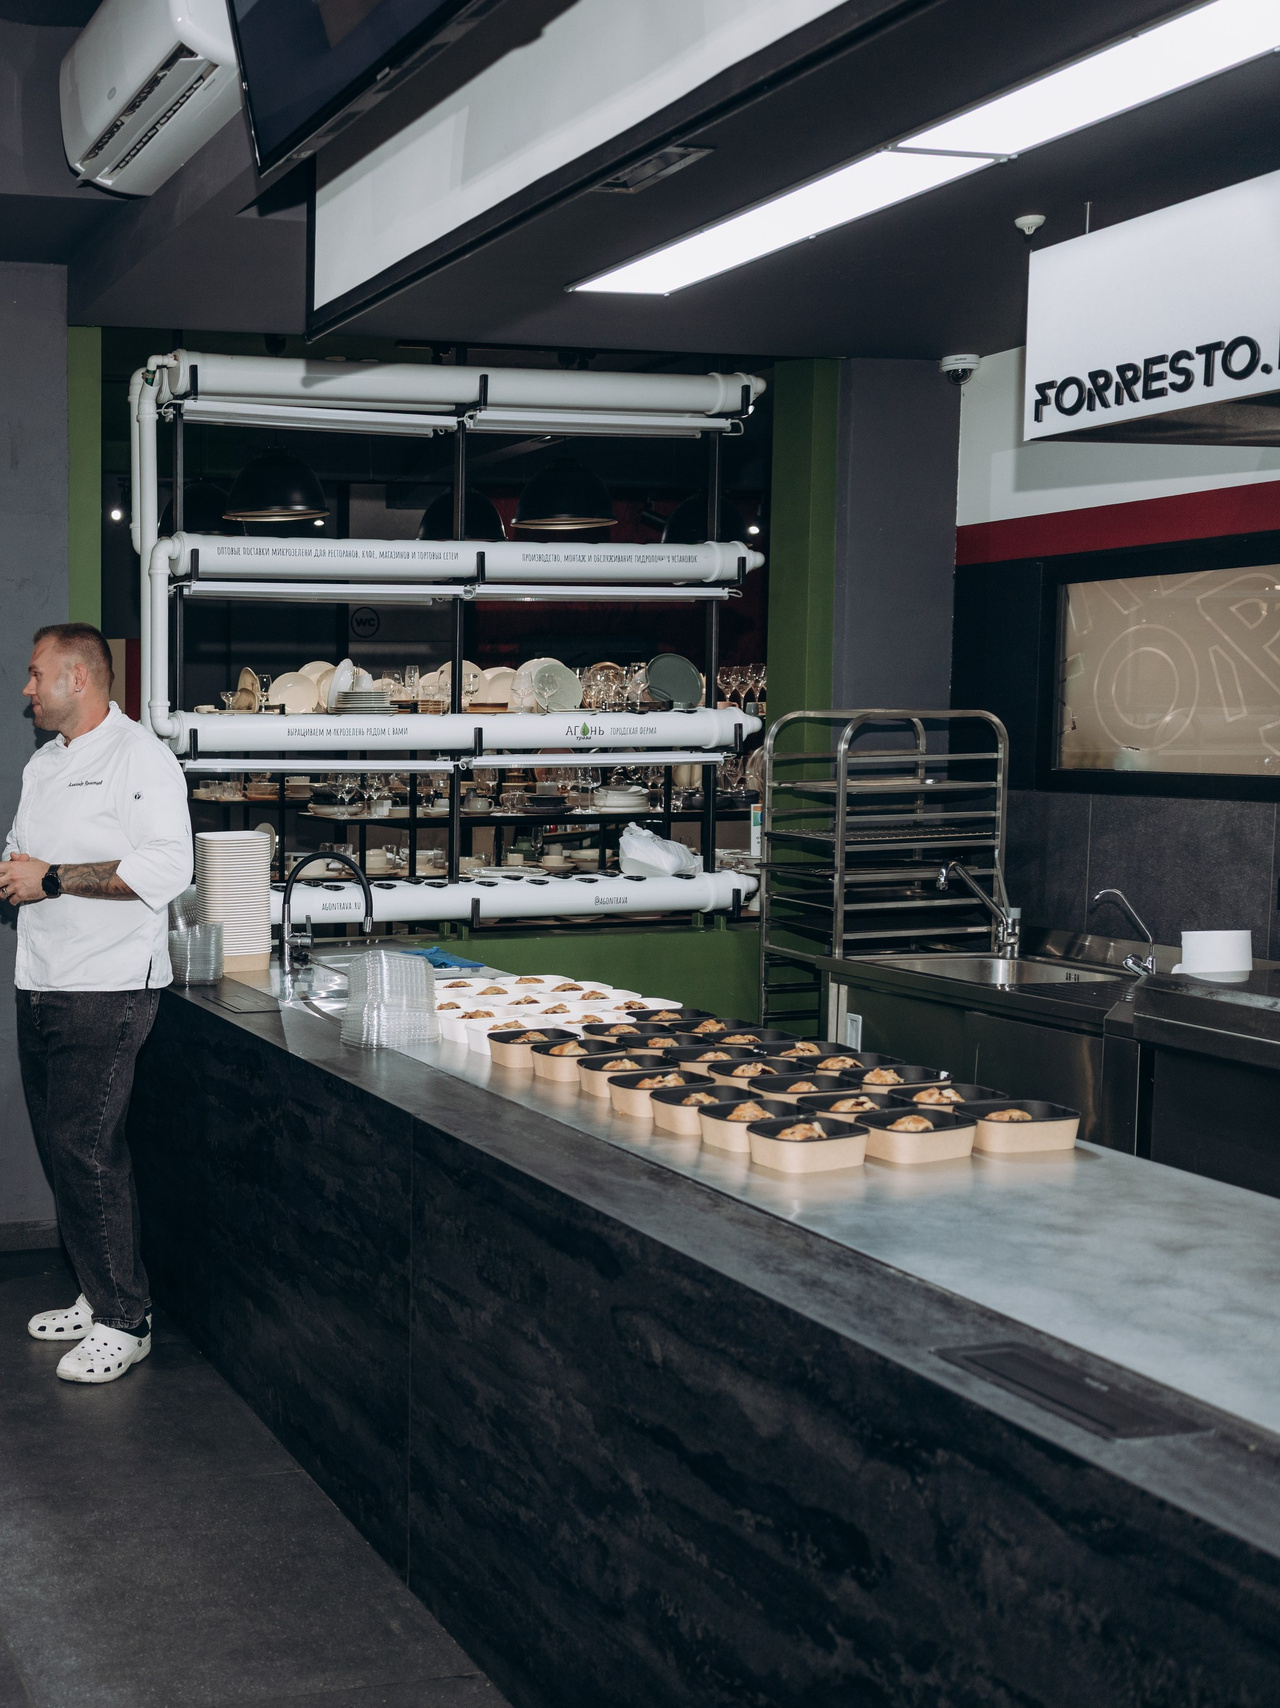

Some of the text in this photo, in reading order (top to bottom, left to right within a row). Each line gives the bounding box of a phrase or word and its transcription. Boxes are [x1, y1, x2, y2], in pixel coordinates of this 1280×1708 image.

[1033, 335, 1280, 423] FORRESTO.
[216, 546, 241, 557] ОПТОВЫЕ
[243, 546, 270, 557] ПОСТАВКИ
[271, 547, 313, 558] МИКРОЗЕЛЕНИ
[314, 548, 327, 558] ДЛЯ
[327, 548, 361, 559] РЕСТОРАНОВ,
[378, 549, 410, 560] МАГАЗИНОВ
[411, 550, 417, 560] И
[417, 551, 442, 561] ТОРГОВЫХ
[521, 553, 563, 563] ПРОИЗВОДСТВО,
[563, 554, 587, 563] МОНТАЖ
[587, 554, 593, 563] И
[593, 554, 633, 564] ОБСЛУЖИВАНИЕ
[671, 554, 698, 564] УСТАНОВОК
[354, 617, 376, 627] WC
[286, 727, 325, 738] ВЫРАЩИВАЕМ
[366, 727, 387, 737] РЯДОМ
[392, 727, 409, 736] ВАМИ
[609, 726, 657, 737] ГОРОДСКАЯ ФЕРМА
[594, 895, 628, 906] @AGONTRAVA
